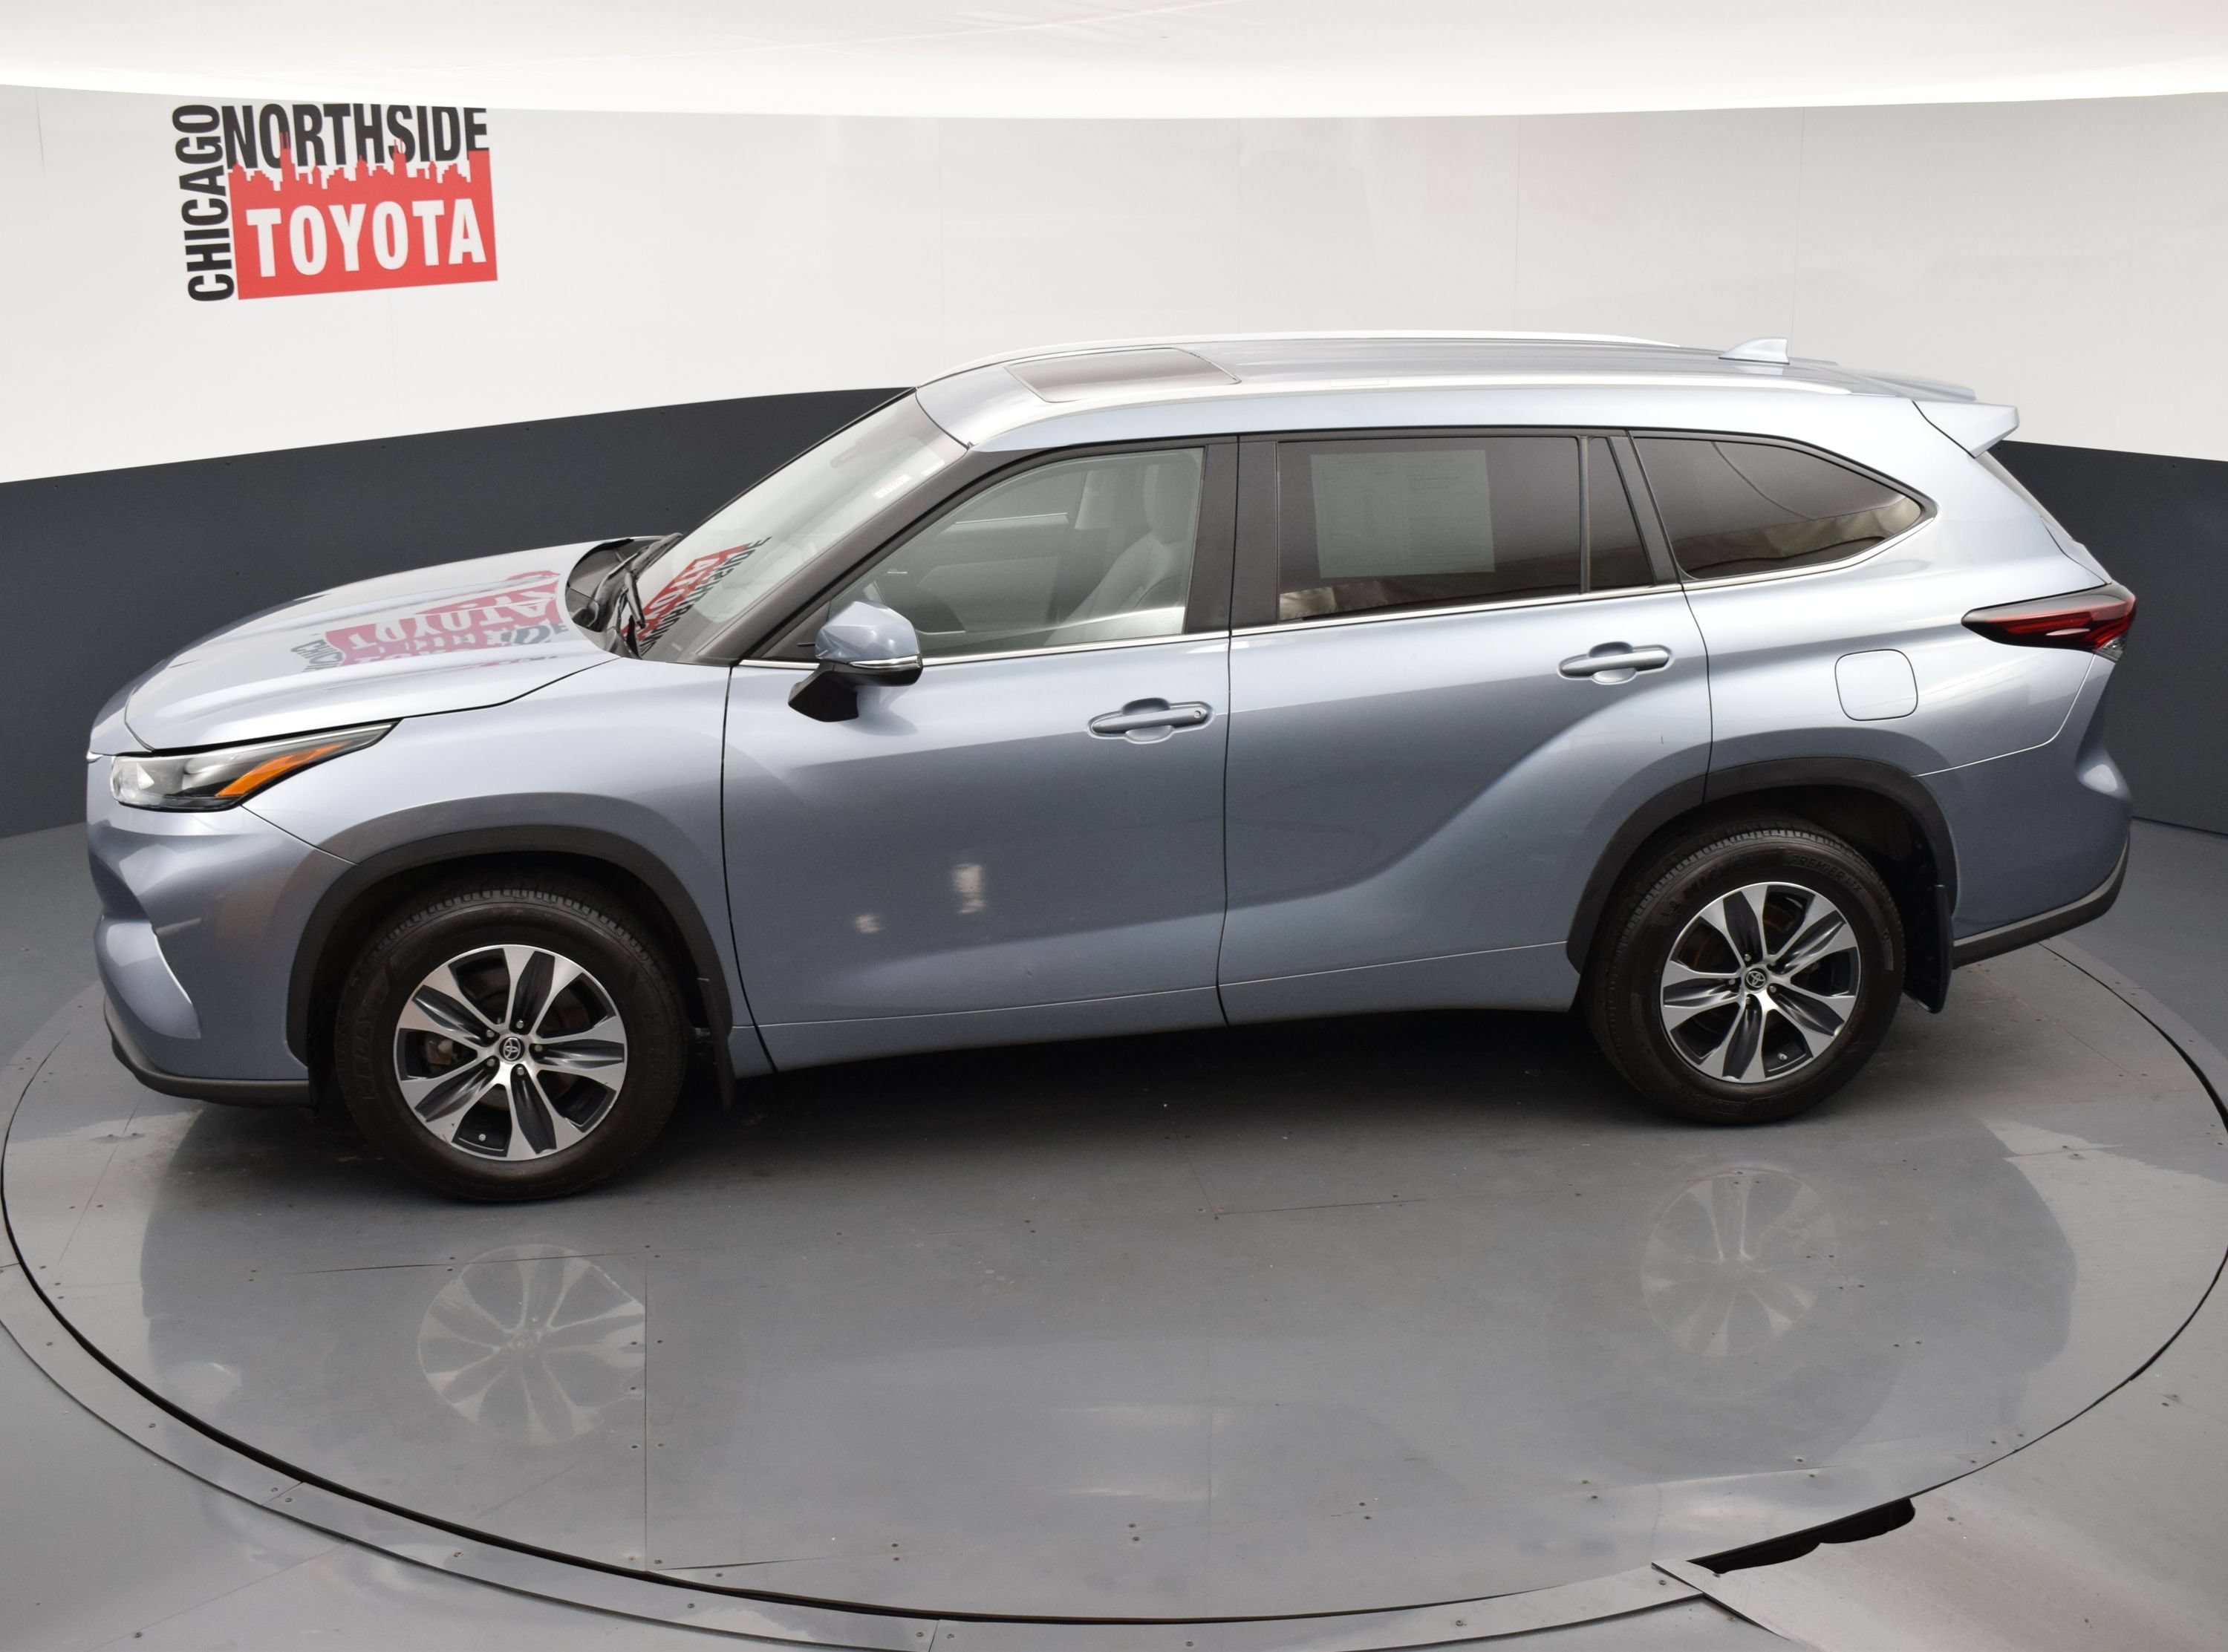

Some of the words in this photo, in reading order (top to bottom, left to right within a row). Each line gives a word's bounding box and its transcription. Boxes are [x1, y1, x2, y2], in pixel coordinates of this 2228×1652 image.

[221, 102, 489, 170] NORTHSIDE
[172, 104, 235, 302] CHICAGO
[245, 197, 487, 278] TOYOTA
